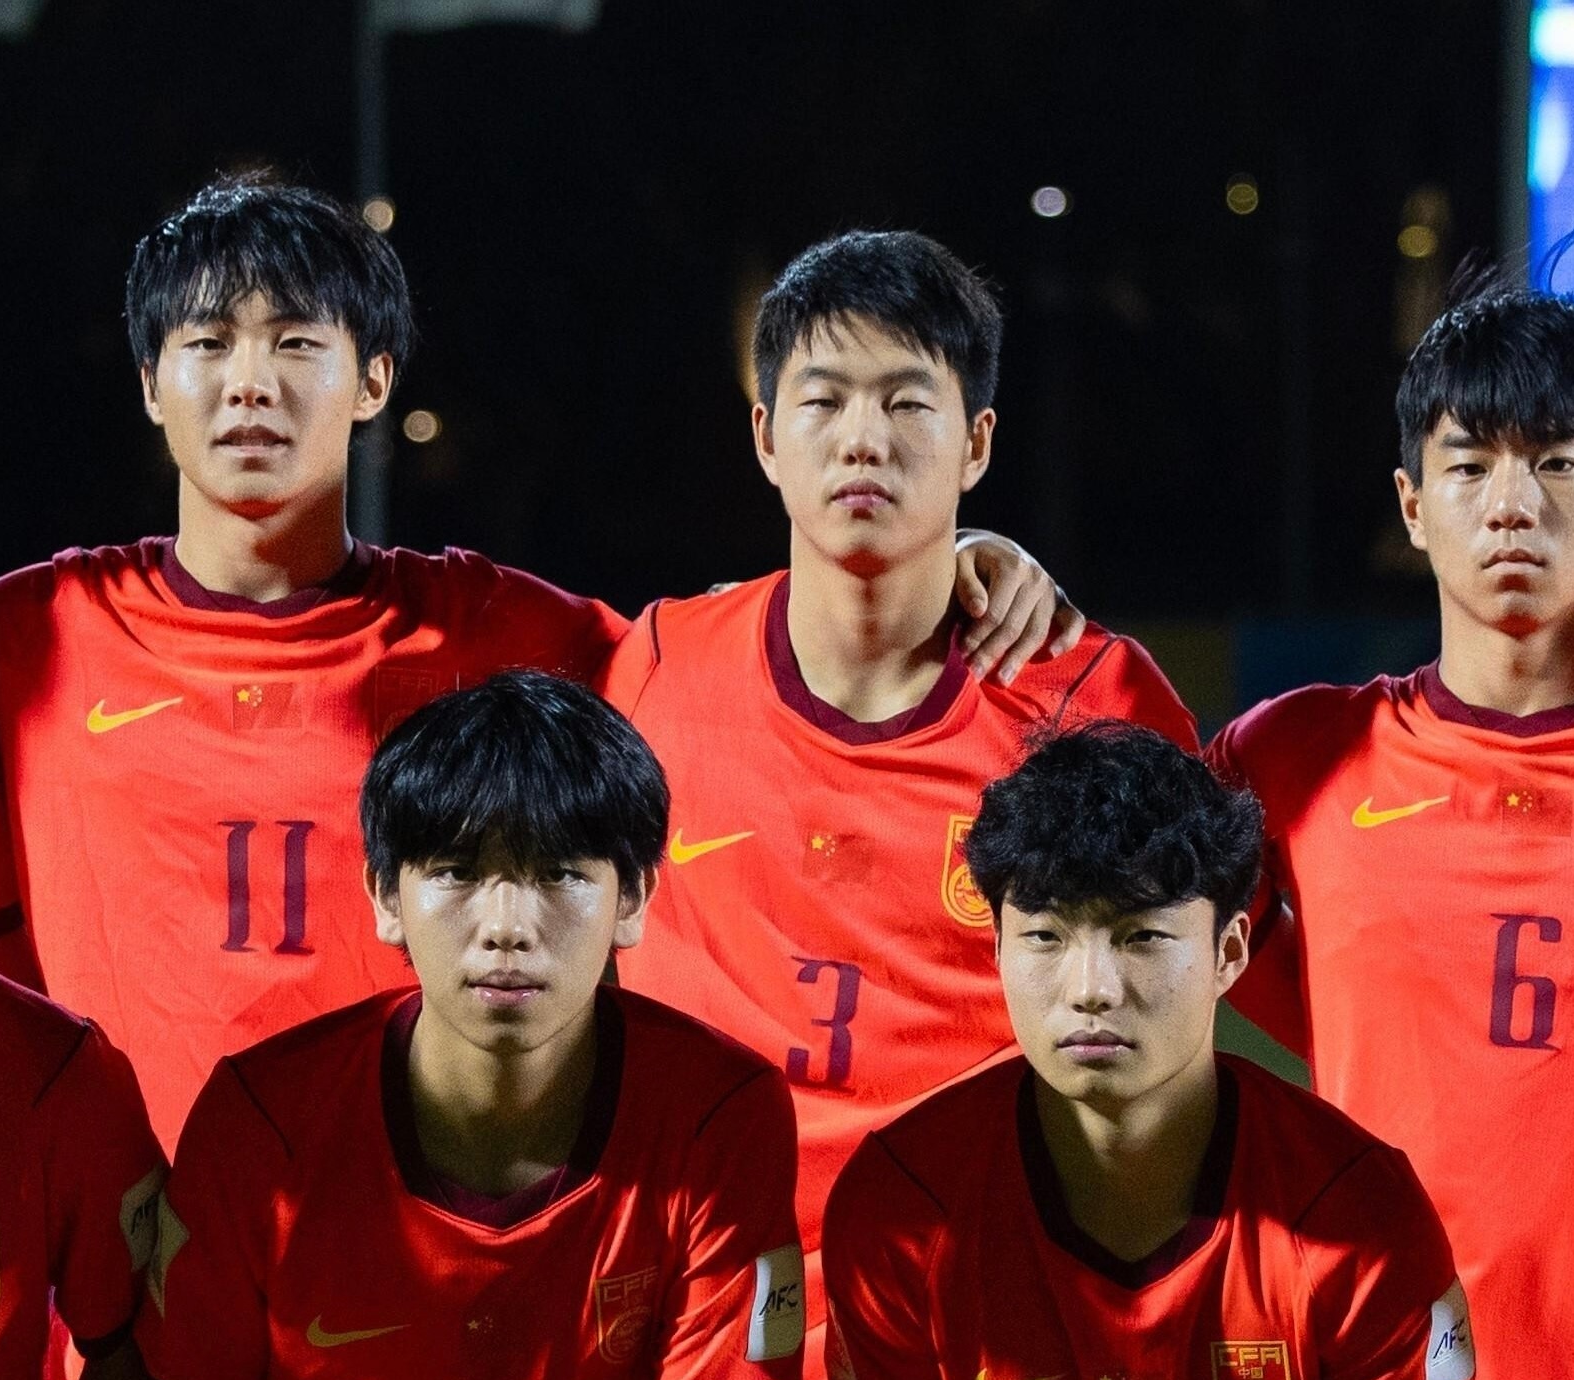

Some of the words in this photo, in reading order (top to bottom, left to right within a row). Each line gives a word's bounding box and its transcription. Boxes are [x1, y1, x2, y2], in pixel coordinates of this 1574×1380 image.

[217, 820, 315, 955] 11
[785, 954, 865, 1098] 3
[1488, 912, 1563, 1052] 6
[758, 1282, 798, 1316] AFC
[1431, 1316, 1467, 1360] AFC
[1219, 1347, 1282, 1367] CFA
